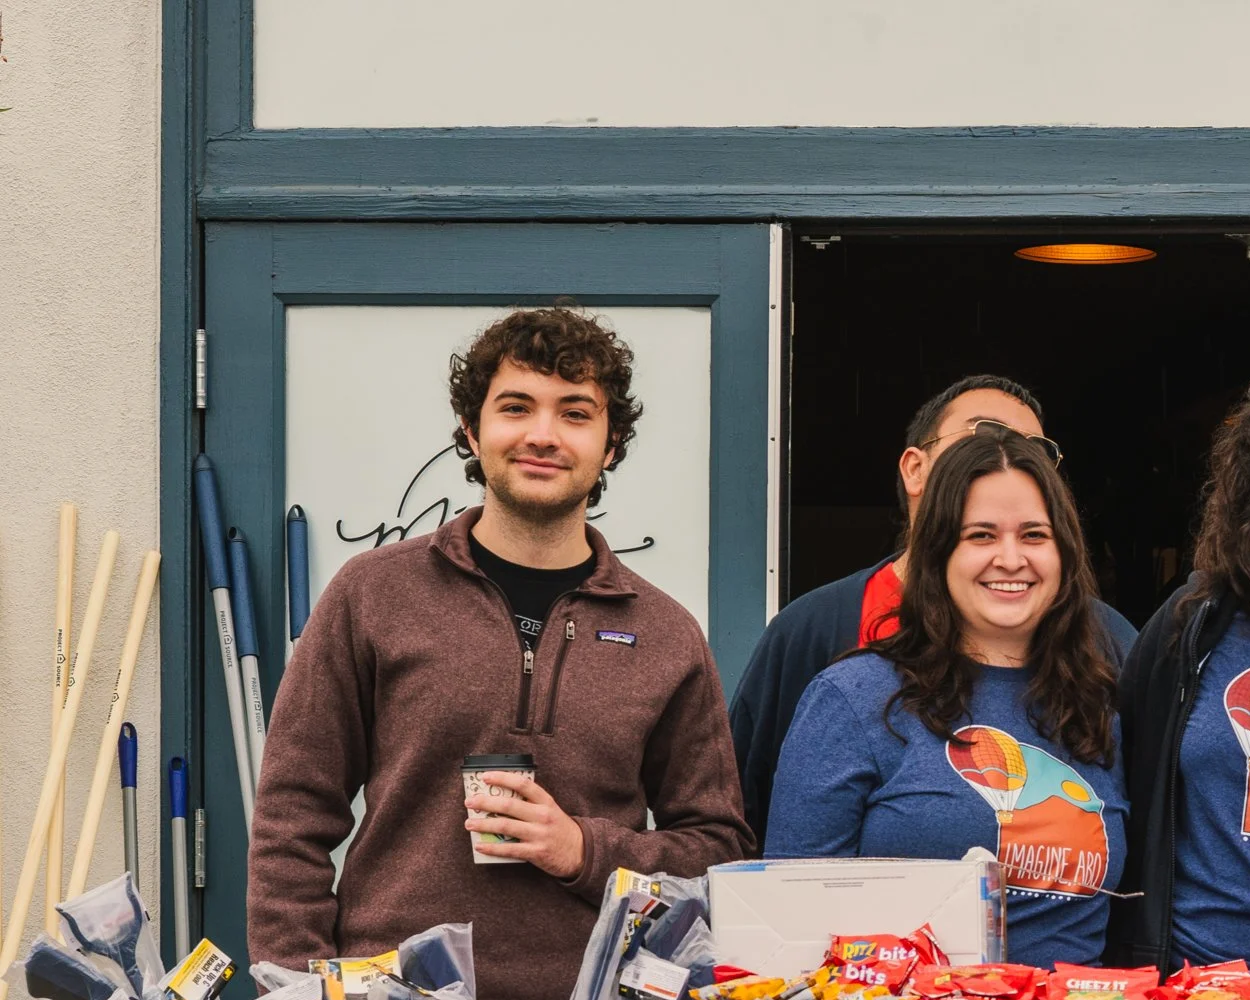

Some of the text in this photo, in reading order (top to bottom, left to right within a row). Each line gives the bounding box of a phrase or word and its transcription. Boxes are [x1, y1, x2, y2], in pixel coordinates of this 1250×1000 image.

[220, 611, 228, 633] PROJECT
[842, 942, 917, 961] RITZ bits
[192, 953, 219, 986] Reach Tool
[213, 959, 227, 974] Pick
[845, 963, 887, 985] bits
[206, 972, 217, 982] Up
